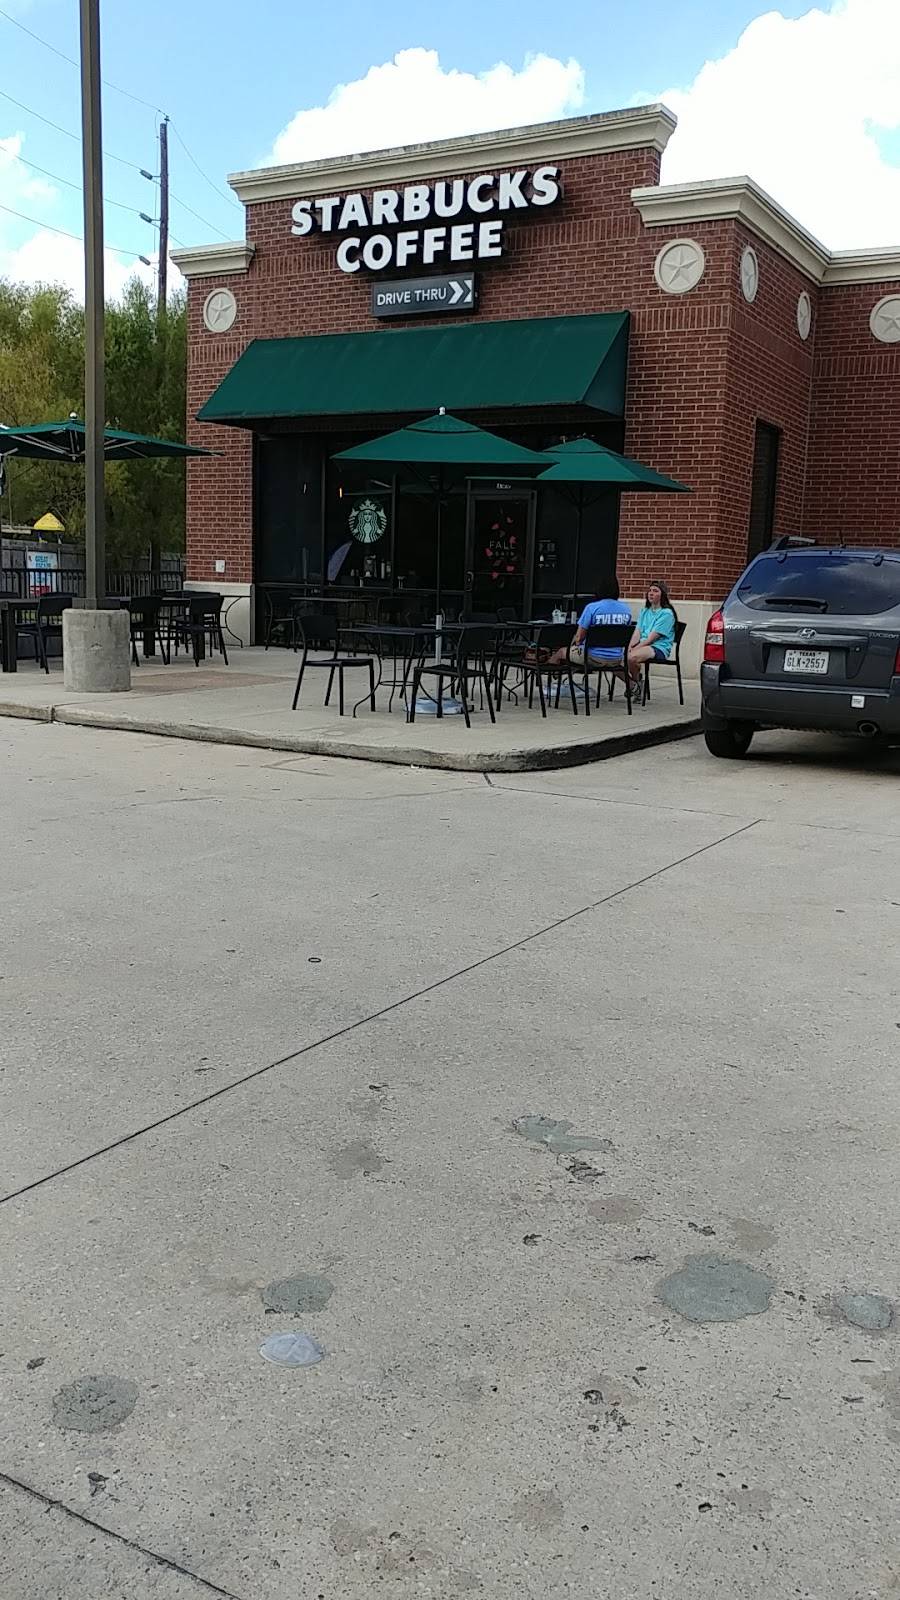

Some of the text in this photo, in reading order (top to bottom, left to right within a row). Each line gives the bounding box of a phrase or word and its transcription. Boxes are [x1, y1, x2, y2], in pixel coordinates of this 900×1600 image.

[290, 166, 559, 236] STARBUCKS
[336, 220, 503, 273] COFFEE
[377, 287, 448, 306] DRIVE THRU
